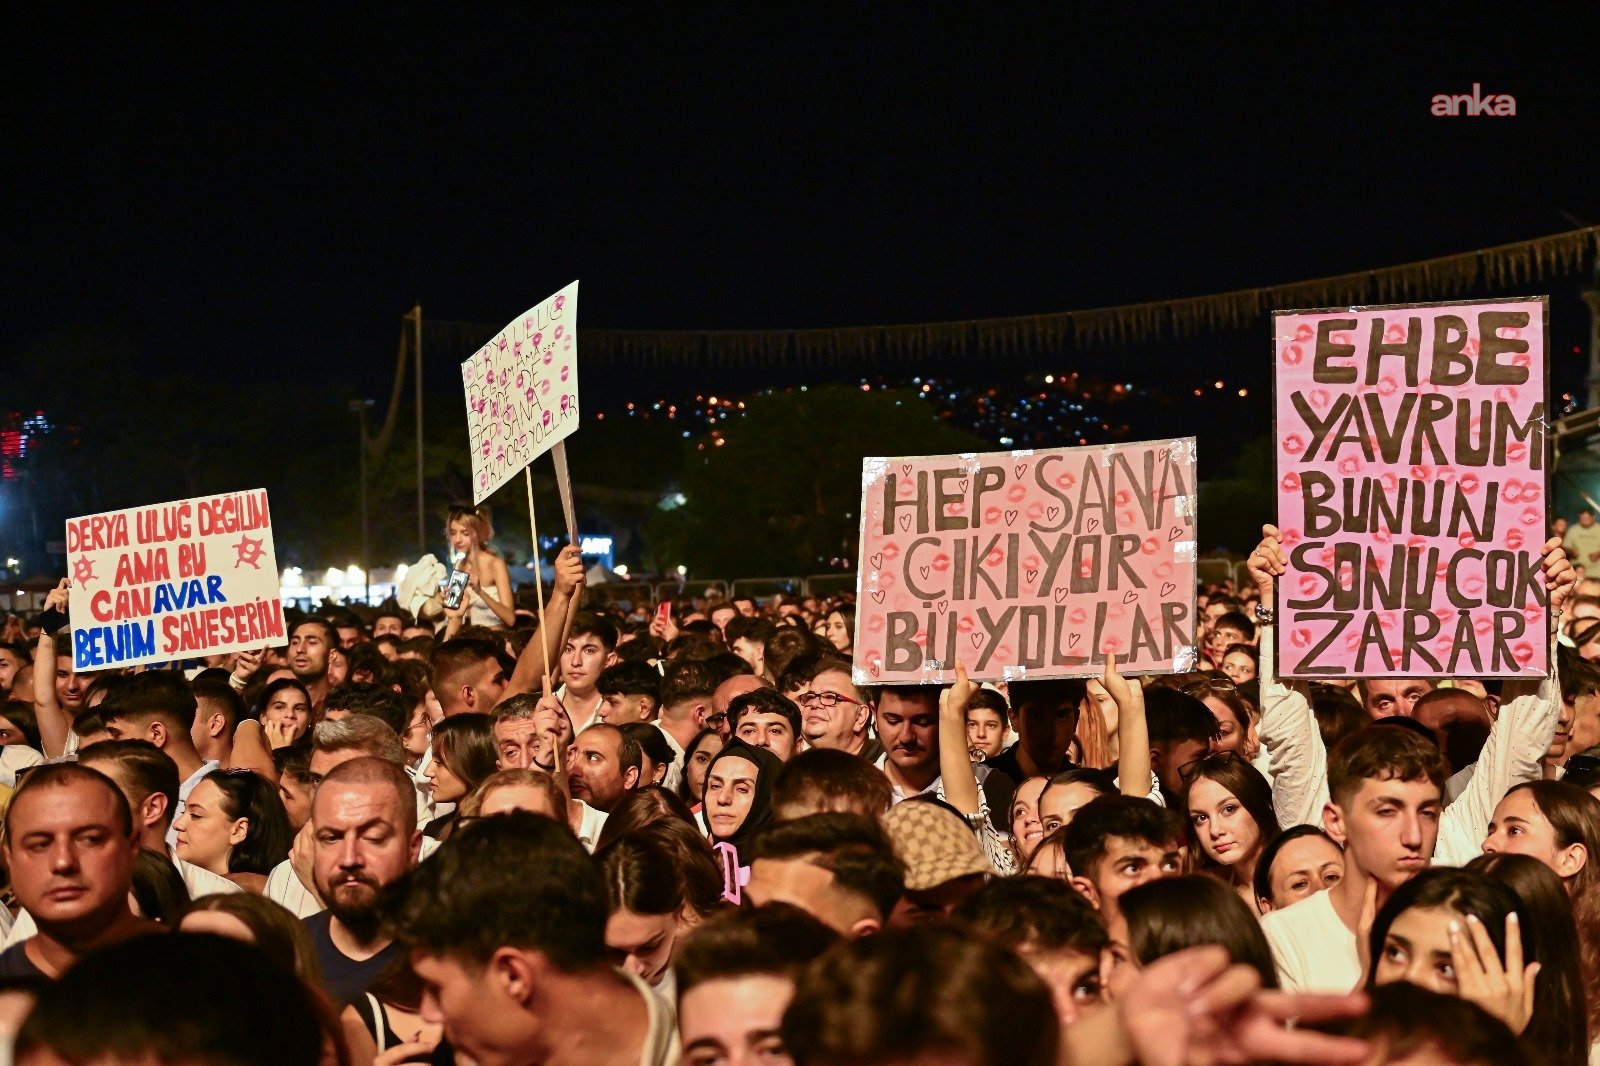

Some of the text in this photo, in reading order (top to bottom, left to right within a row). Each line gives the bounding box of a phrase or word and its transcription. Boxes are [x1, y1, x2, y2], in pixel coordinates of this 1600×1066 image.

[1290, 391, 1545, 471] YAVRUM
[883, 448, 1194, 535] HEP SANA
[1299, 471, 1499, 542] BUNUN
[67, 513, 129, 554] DERYA
[136, 500, 192, 545] ULUĞ
[114, 541, 207, 587] AMA BU
[74, 619, 156, 669] BENİM
[974, 601, 1193, 672] YOLLAR
[1293, 609, 1526, 674] ZARAR
